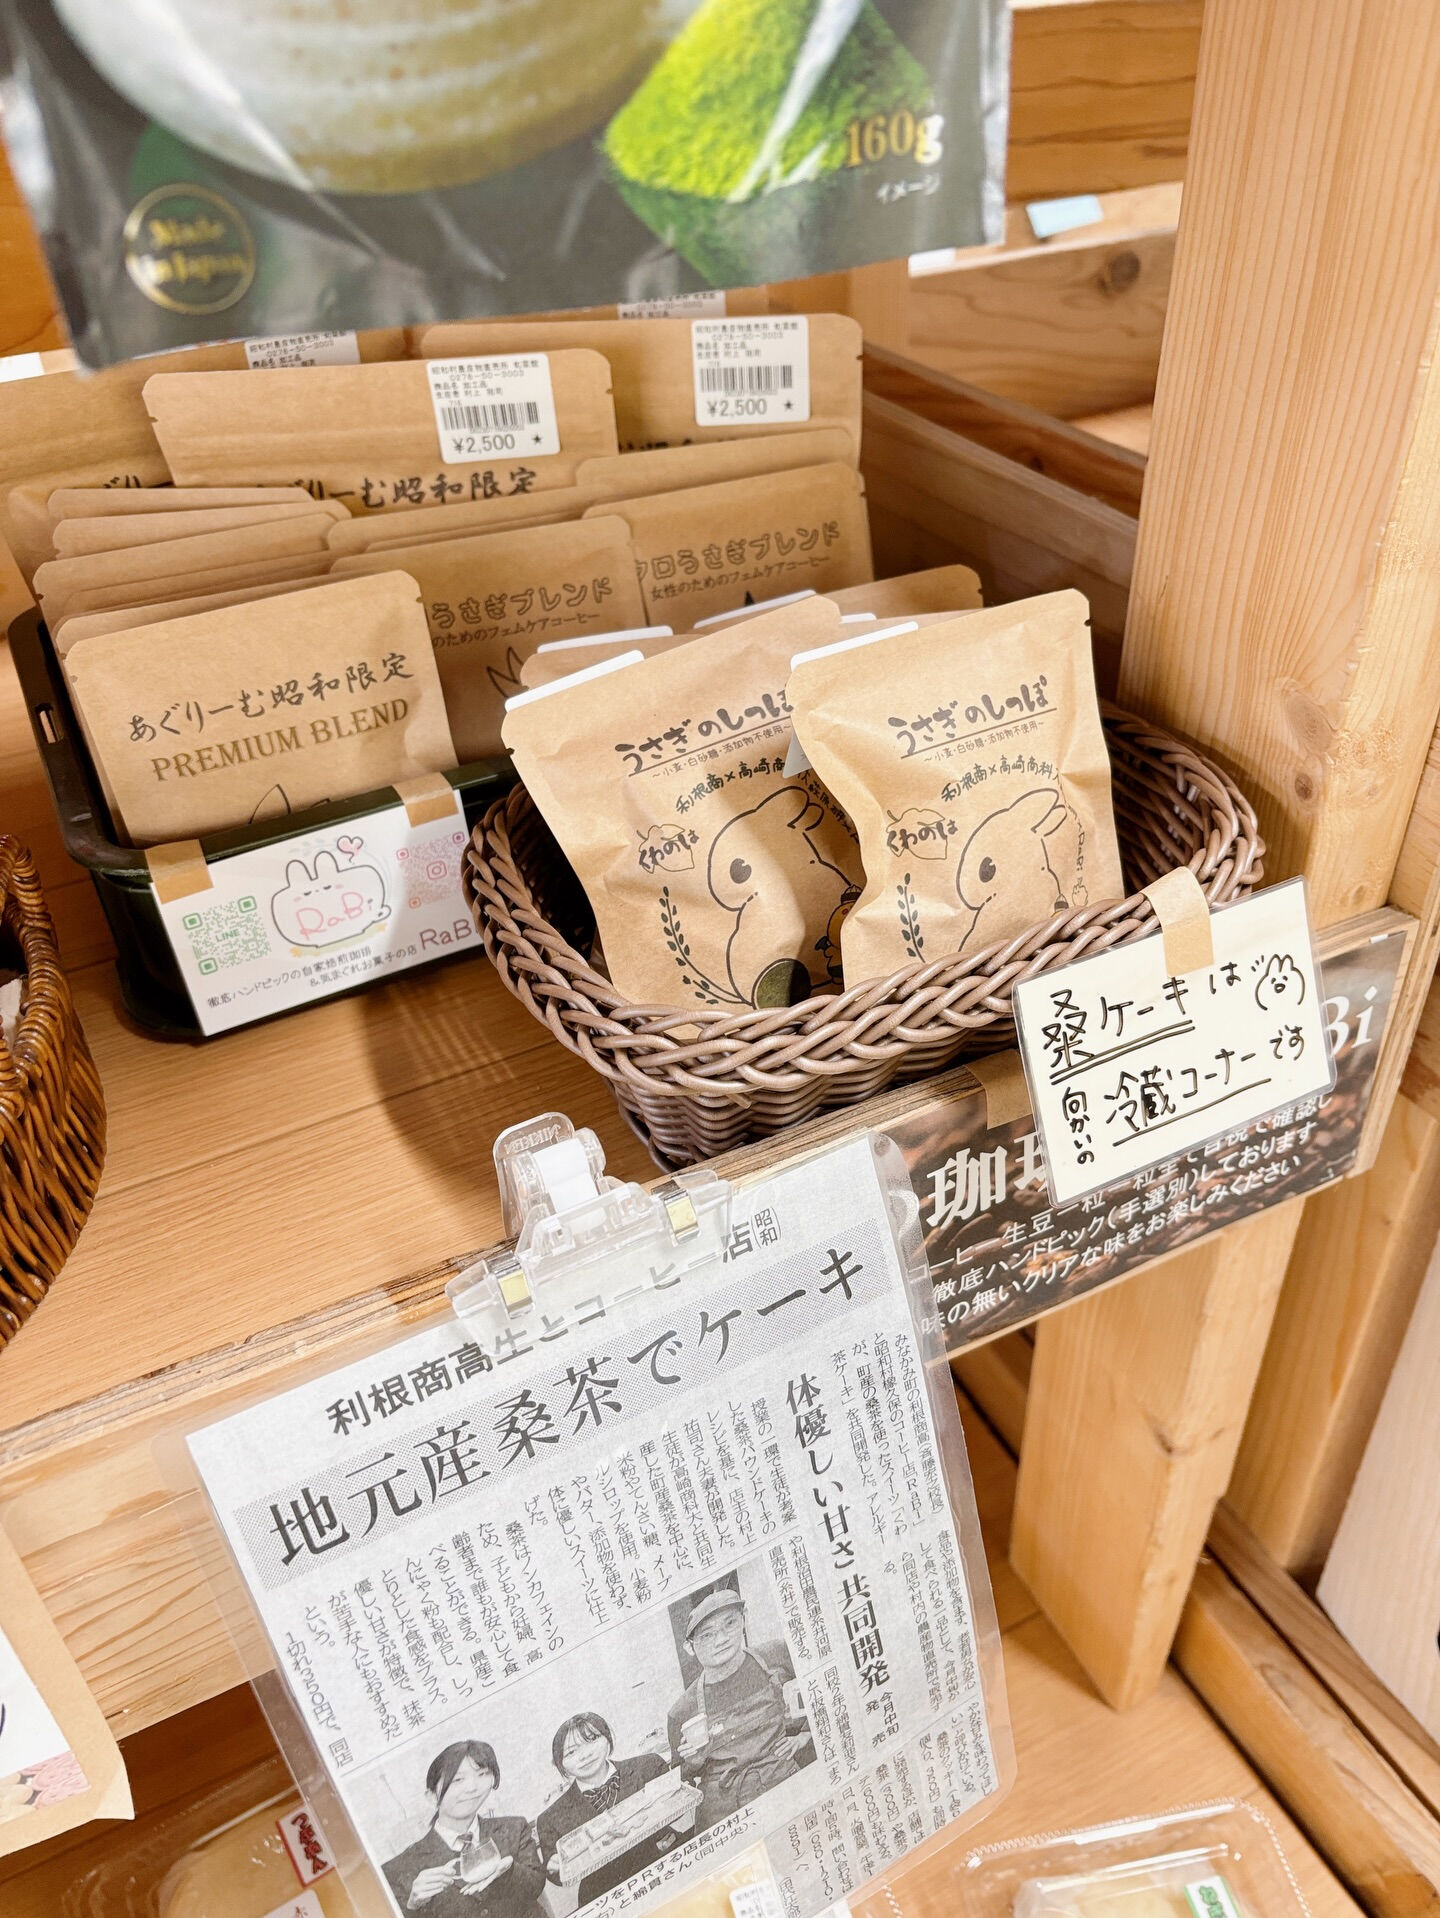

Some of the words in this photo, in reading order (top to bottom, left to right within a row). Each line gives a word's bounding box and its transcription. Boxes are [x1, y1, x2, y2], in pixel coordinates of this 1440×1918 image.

[845, 109, 944, 168] 160g
[452, 433, 516, 454] ¥2,500
[707, 399, 768, 417] ¥2,500
[651, 554, 830, 601] 女性のためのフェムケアコーヒー
[129, 652, 414, 743] あぐりーむ昭和限定
[151, 726, 304, 782] PREMIUM
[309, 698, 409, 744] BLEND
[888, 675, 1048, 756] うさぎのしっぽ
[639, 829, 700, 868] くわのは
[886, 819, 959, 853] くわのは
[215, 929, 240, 942] LINE
[1062, 1086, 1095, 1165] 向かいの
[933, 1121, 1319, 1304] 徹底ハンドピック(手選別)しております
[273, 1254, 862, 1563] 地元産桑茶でケーキ
[728, 1401, 776, 1534] した桑茶パウンドケーキの
[751, 1397, 796, 1524] 授業の一環で生徒が考案
[523, 1495, 548, 1530] げた。
[616, 1451, 671, 1591] 米粉やてんさい糖、メープ
[639, 1439, 693, 1569] 産した町産桑茶を中心に、
[661, 1430, 716, 1569] 生徒が高崎商科大と共同生
[684, 1418, 735, 1547] 祐司さん夫妻が開発した。
[707, 1410, 756, 1546] レシピを基に、店主の村上
[786, 1373, 854, 1569] 体優しい甘さ
[838, 1574, 889, 1696] 共同開発
[428, 1545, 495, 1687] べることができる。県産こ
[451, 1531, 519, 1677] 齢者まで誰もが安心して食
[477, 1522, 542, 1665] ため、子どもから妊婦、高
[505, 1520, 564, 1651] 桑茶はノンカフェインの
[547, 1485, 609, 1627] 体に優しいスイーツに仕上
[303, 1604, 336, 1653] という。
[328, 1590, 401, 1740] が苦手な人にもおすすめだ
[353, 1578, 424, 1726] 優しい甘さが特徴で、抹茶
[381, 1569, 447, 1703] とりとした食感をプラス。
[405, 1558, 473, 1696] んにゃく粉も配合し、しっ
[879, 1691, 899, 1736] 今月中旬
